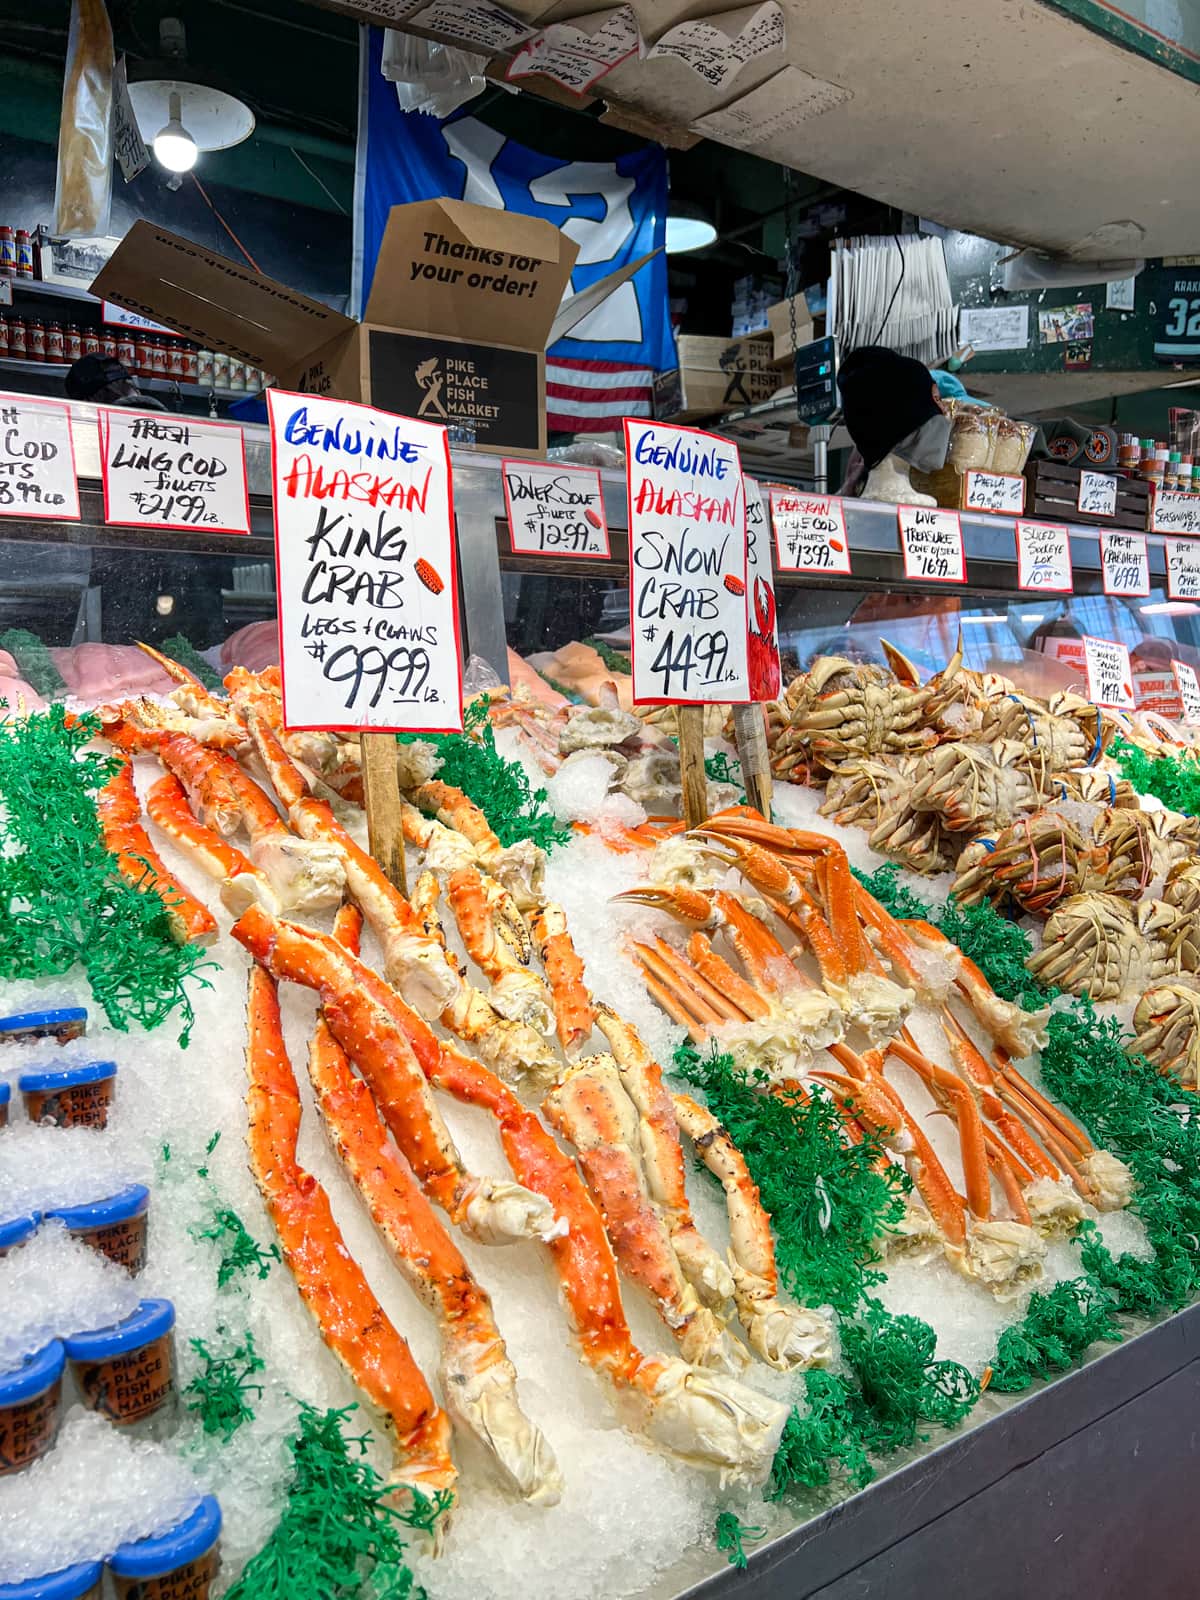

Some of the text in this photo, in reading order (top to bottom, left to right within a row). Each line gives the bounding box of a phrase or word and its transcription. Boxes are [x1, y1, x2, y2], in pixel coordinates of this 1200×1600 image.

[422, 232, 504, 266] Thanks
[409, 261, 538, 298] your order!
[1174, 280, 1200, 293] KRAK
[446, 359, 475, 374] PIKE
[446, 373, 489, 390] PLACE
[446, 387, 475, 402] FISH
[446, 402, 500, 418] MARKET
[5, 428, 58, 461] COD
[177, 452, 229, 478] COD
[282, 453, 434, 515] ALASKAN
[633, 478, 740, 529] ALASKAN
[776, 497, 830, 515] ALASKAN
[915, 510, 940, 526] LIVE
[903, 526, 955, 545] TREASURE
[633, 528, 731, 577] SNOW
[301, 560, 405, 609] CRAB
[637, 575, 721, 621] CRAB
[300, 612, 358, 639] LEGS
[641, 624, 730, 697] $44.99
[303, 640, 430, 710] $99.99
[70, 1085, 101, 1101] PIKE
[72, 1110, 101, 1126] FISH
[112, 1349, 149, 1371] PIKE
[114, 1357, 162, 1386] PLACE
[116, 1382, 151, 1401] FISH
[118, 1379, 175, 1414] MARKET
